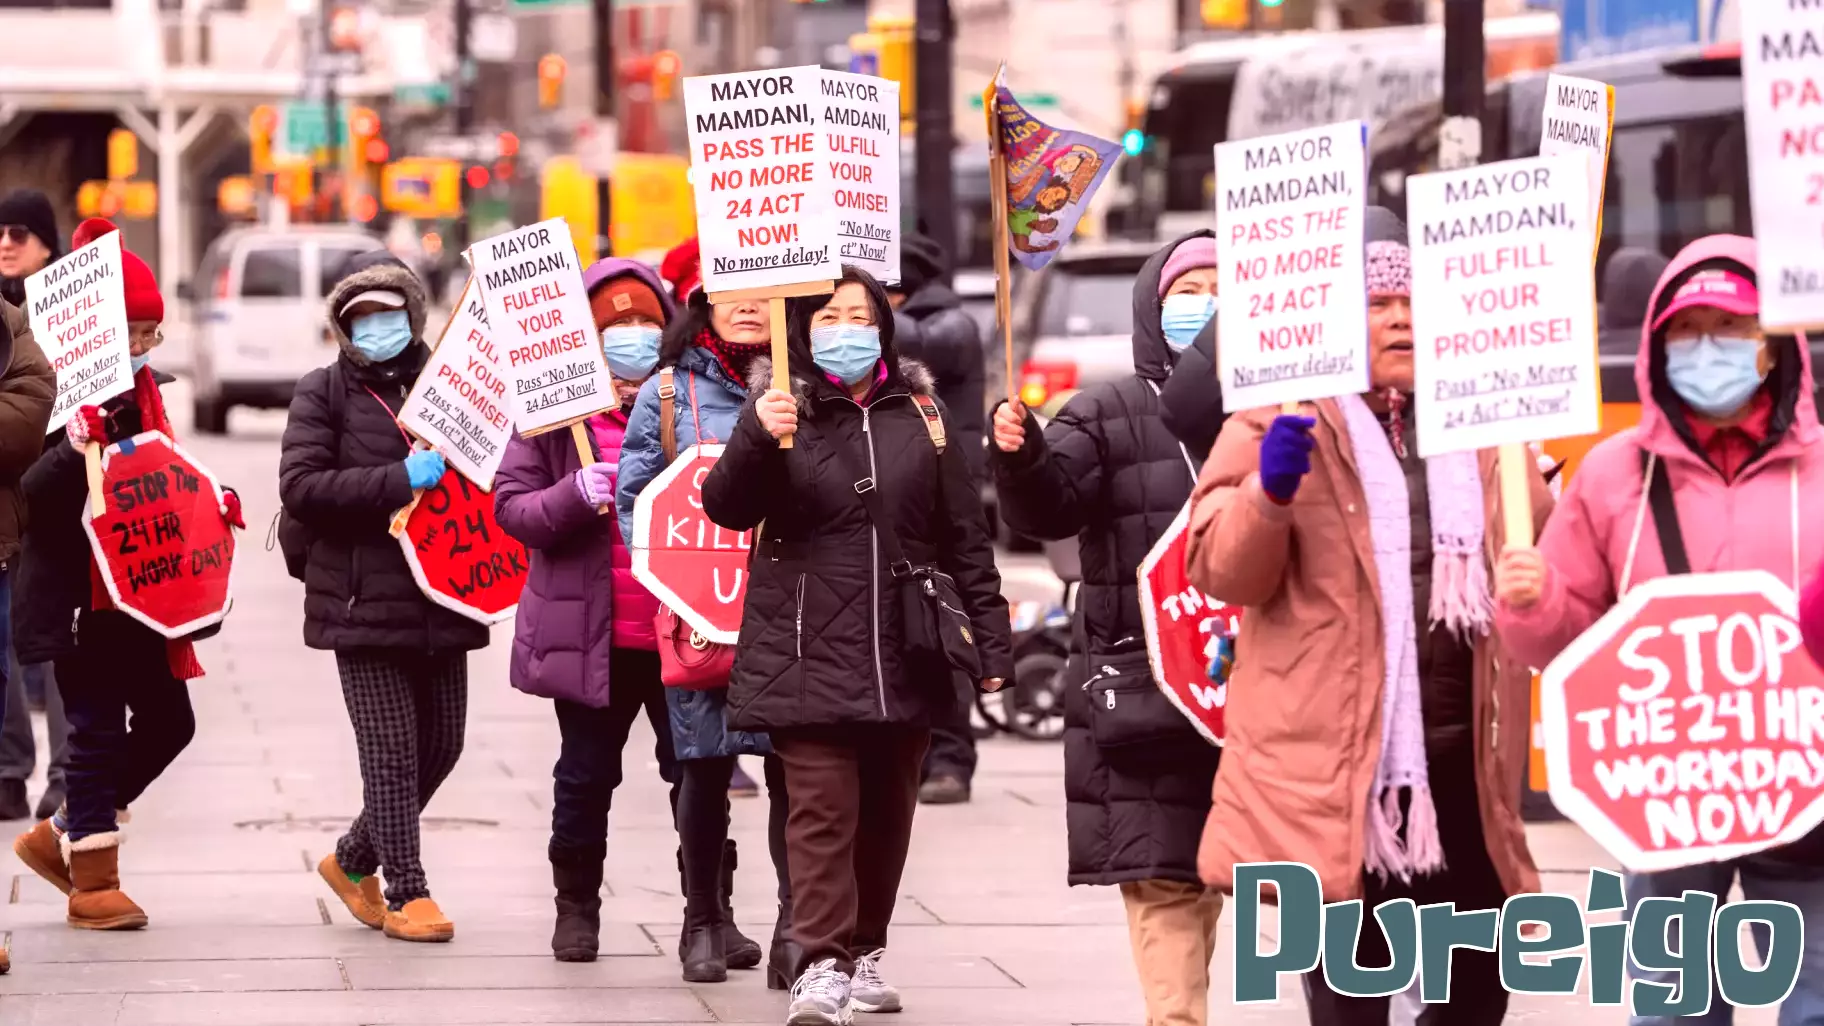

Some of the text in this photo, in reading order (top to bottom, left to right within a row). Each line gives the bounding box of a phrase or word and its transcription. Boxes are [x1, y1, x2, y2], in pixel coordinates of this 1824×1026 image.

[1761, 30, 1824, 62] MA
[711, 75, 794, 102] MAYOR
[821, 78, 879, 103] MAYOR
[1557, 85, 1599, 112] MAYOR
[1771, 77, 1824, 111] PA
[696, 103, 815, 133] MAMDANI,
[824, 105, 890, 136] AMDANI,
[1546, 117, 1601, 154] MAMDANI,
[703, 132, 815, 162] PASS THE
[827, 133, 880, 158] ULFILL
[1244, 136, 1332, 171] MAYOR
[711, 162, 814, 192] NO MORE
[829, 161, 873, 184] YOUR
[1227, 170, 1352, 212] MAMDANI,
[1445, 167, 1550, 205] MAYOR
[726, 192, 805, 220] 24 ACT
[834, 189, 888, 213] OMISE!
[737, 223, 799, 248] NOW!
[840, 220, 891, 240] “No More
[1231, 206, 1349, 247] PASS THE
[1423, 202, 1575, 246] MAMDANI,
[492, 228, 551, 261] MAYOR
[713, 245, 829, 273] No more delay!
[840, 242, 887, 260] ct” Now!
[1444, 243, 1553, 281] FULFILL
[44, 246, 100, 288] MAYOR
[485, 251, 570, 290] MAMDANI,
[1235, 244, 1343, 284] NO MORE
[35, 263, 114, 316] MAMDANI,
[503, 281, 566, 313] FULFILL
[1248, 282, 1332, 319] 24 ACT
[1461, 283, 1540, 315] YOUR
[47, 290, 104, 332] FULFILL
[517, 309, 564, 336] YOUR
[57, 314, 98, 347] YOUR
[509, 329, 587, 367] PROMISE!
[1258, 322, 1323, 353] NOW!
[1434, 317, 1572, 360] PROMISE!
[57, 352, 121, 397] ss “No More
[467, 355, 507, 399] YOUR
[516, 360, 596, 395] Pass “No More
[1233, 348, 1354, 386] No more delay!
[1435, 378, 1477, 402] Pass
[1525, 364, 1577, 387] More
[65, 384, 88, 410] Act”
[90, 367, 118, 395] Now!
[437, 363, 509, 432] PROMISE!
[525, 378, 597, 413] 24 Act” Now!
[423, 386, 499, 453] Pass “No More
[1444, 410, 1464, 429] 24
[1516, 388, 1570, 418] Now!
[418, 407, 487, 466] 24 Act” Now!
[113, 463, 200, 513] STOP THE
[112, 512, 185, 555] 24 HR
[418, 509, 491, 559] THE 24
[666, 514, 752, 549] KILL
[127, 538, 233, 595] WORK DAY!
[448, 548, 528, 598] WORK
[1617, 612, 1804, 703] STOP
[1575, 685, 1824, 751] THE 24 HR
[1593, 747, 1824, 801] WORKDAY
[1644, 789, 1794, 849] NOW
